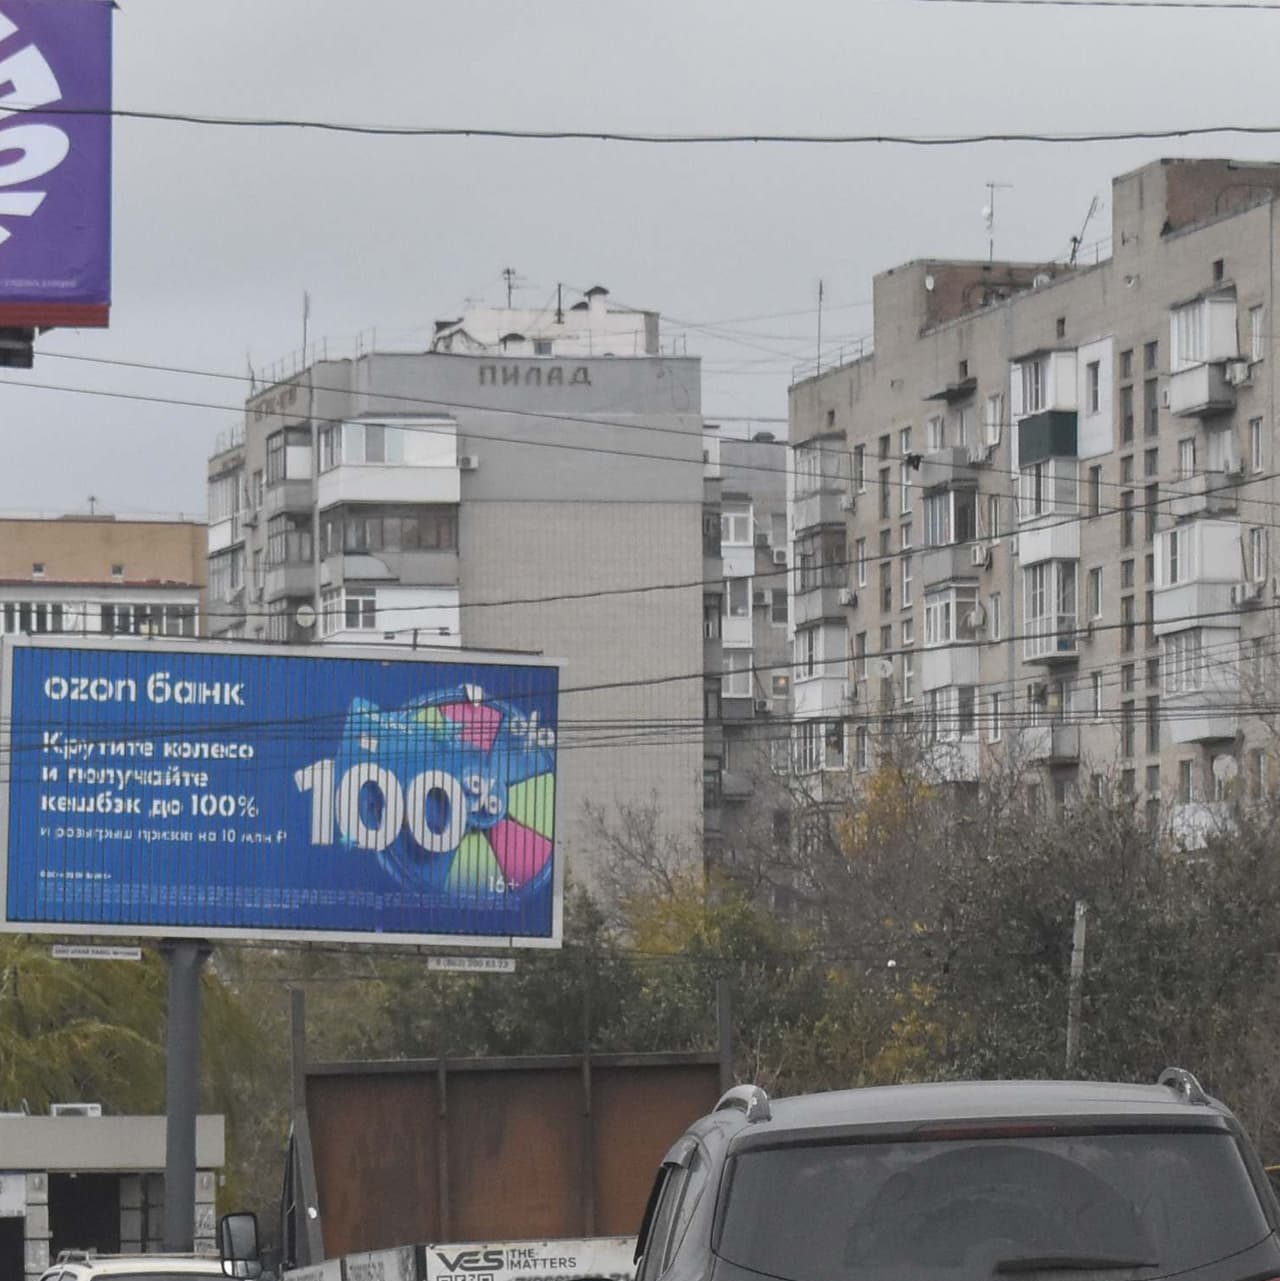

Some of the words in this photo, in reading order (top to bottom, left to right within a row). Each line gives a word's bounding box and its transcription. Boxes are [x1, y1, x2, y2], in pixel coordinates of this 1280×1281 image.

[44, 675, 136, 702] ozon
[147, 671, 245, 706] банк
[42, 730, 153, 760] Крутите
[163, 740, 254, 760] колесо
[42, 766, 58, 782] и
[67, 765, 209, 790] получайте
[40, 790, 141, 814] кешбэк
[148, 798, 183, 818] до
[191, 793, 260, 818] 100%
[40, 827, 51, 838] и
[198, 831, 217, 843] на
[222, 828, 236, 843] 10
[488, 875, 521, 894] 16+
[436, 1250, 505, 1273] VES
[510, 1257, 578, 1271] MATTERS
[511, 1248, 536, 1259] THE
